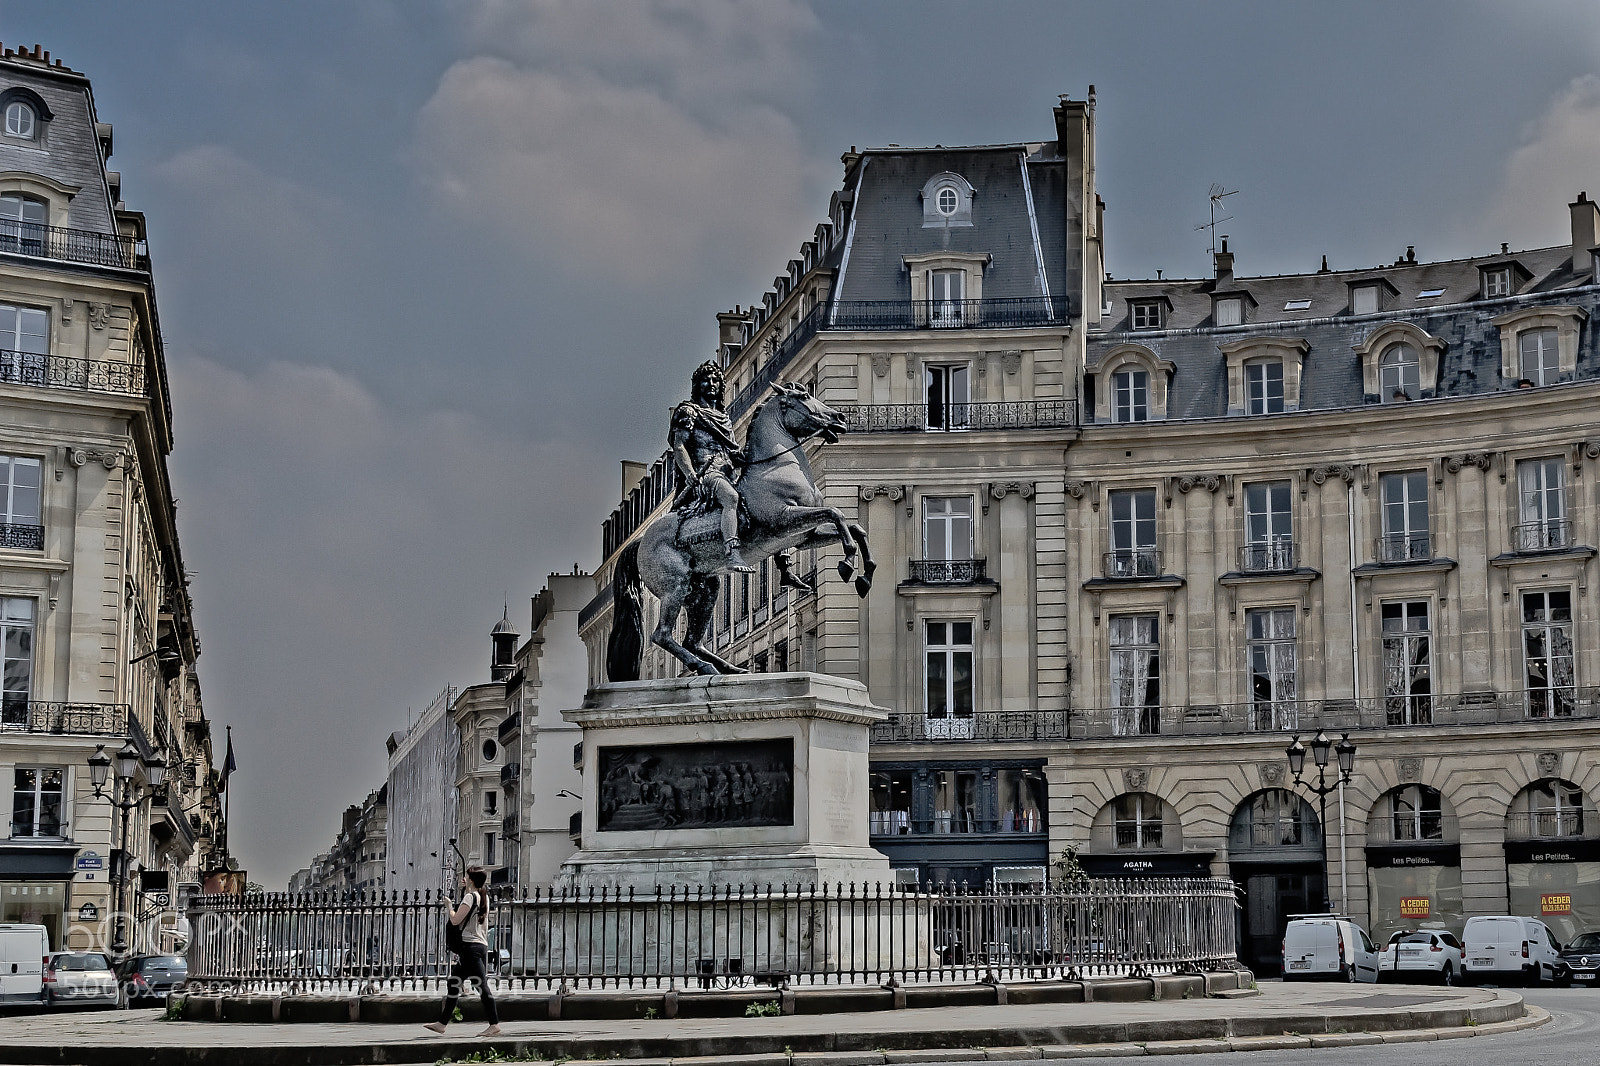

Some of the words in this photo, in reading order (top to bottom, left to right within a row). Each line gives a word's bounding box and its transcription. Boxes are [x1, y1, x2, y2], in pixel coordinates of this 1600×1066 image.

[1532, 853, 1544, 861] Les
[1400, 899, 1406, 908] A
[1407, 899, 1430, 908] CEDER
[1541, 896, 1547, 905] A
[1548, 895, 1571, 905] CEDER
